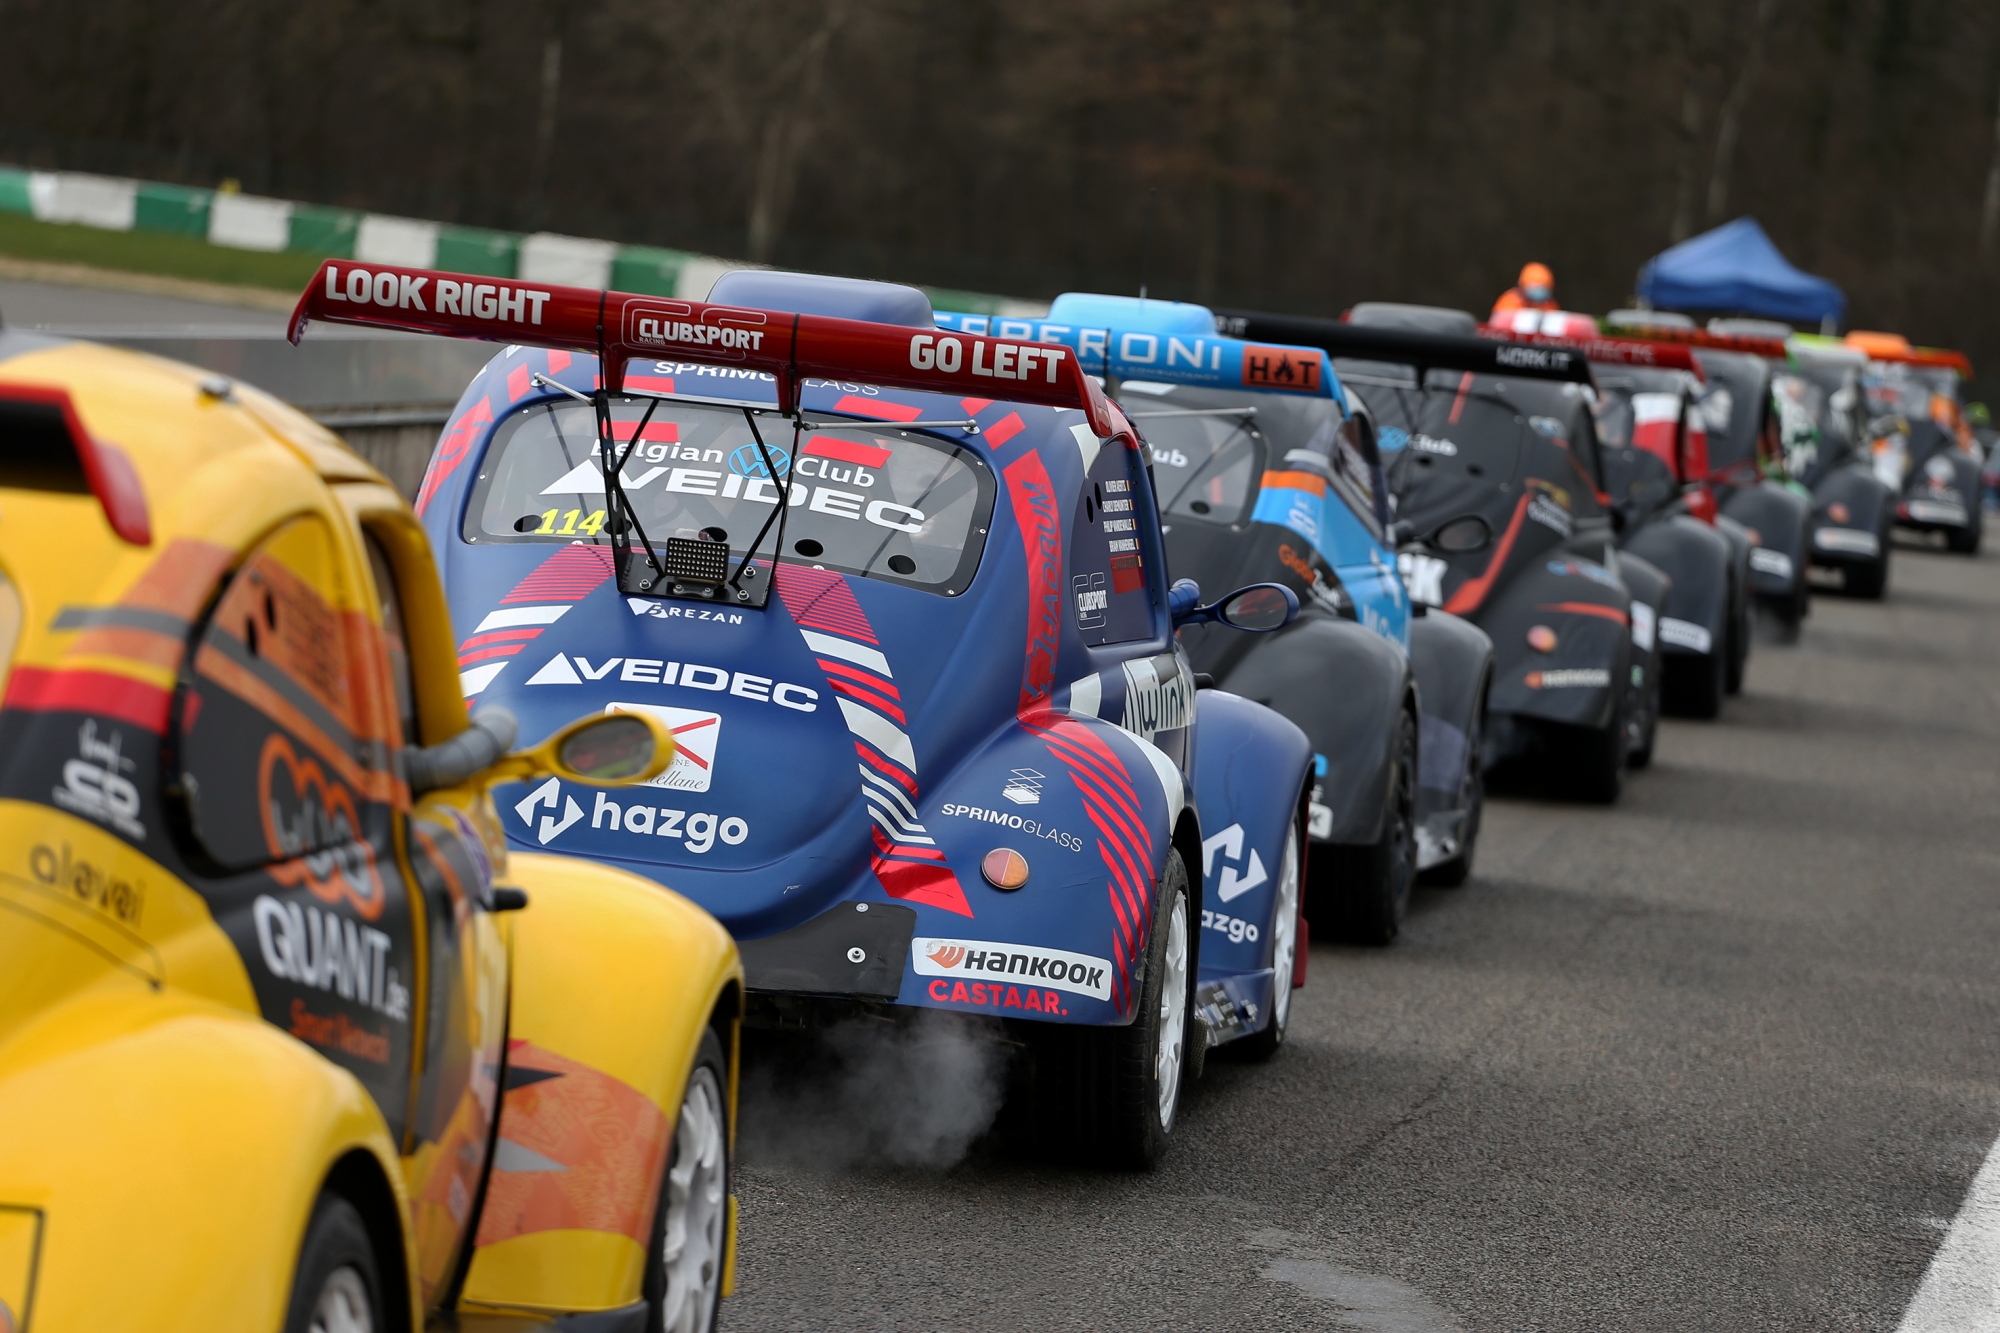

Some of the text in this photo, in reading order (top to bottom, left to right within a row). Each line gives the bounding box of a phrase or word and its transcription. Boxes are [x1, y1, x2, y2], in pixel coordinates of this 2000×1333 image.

[326, 266, 550, 325] LOOK RIGHT
[638, 336, 666, 346] RACING
[639, 318, 764, 350] CLUBSPORT
[909, 334, 1066, 384] GO LEFT
[795, 457, 875, 488] Club
[534, 508, 606, 536] 114
[524, 652, 819, 713] AVEIDEC
[591, 792, 749, 854] hazgo
[941, 802, 1083, 853] SPRIMOGLASS
[1201, 909, 1259, 944] azgo
[928, 979, 1069, 1016] CASTAAR.
